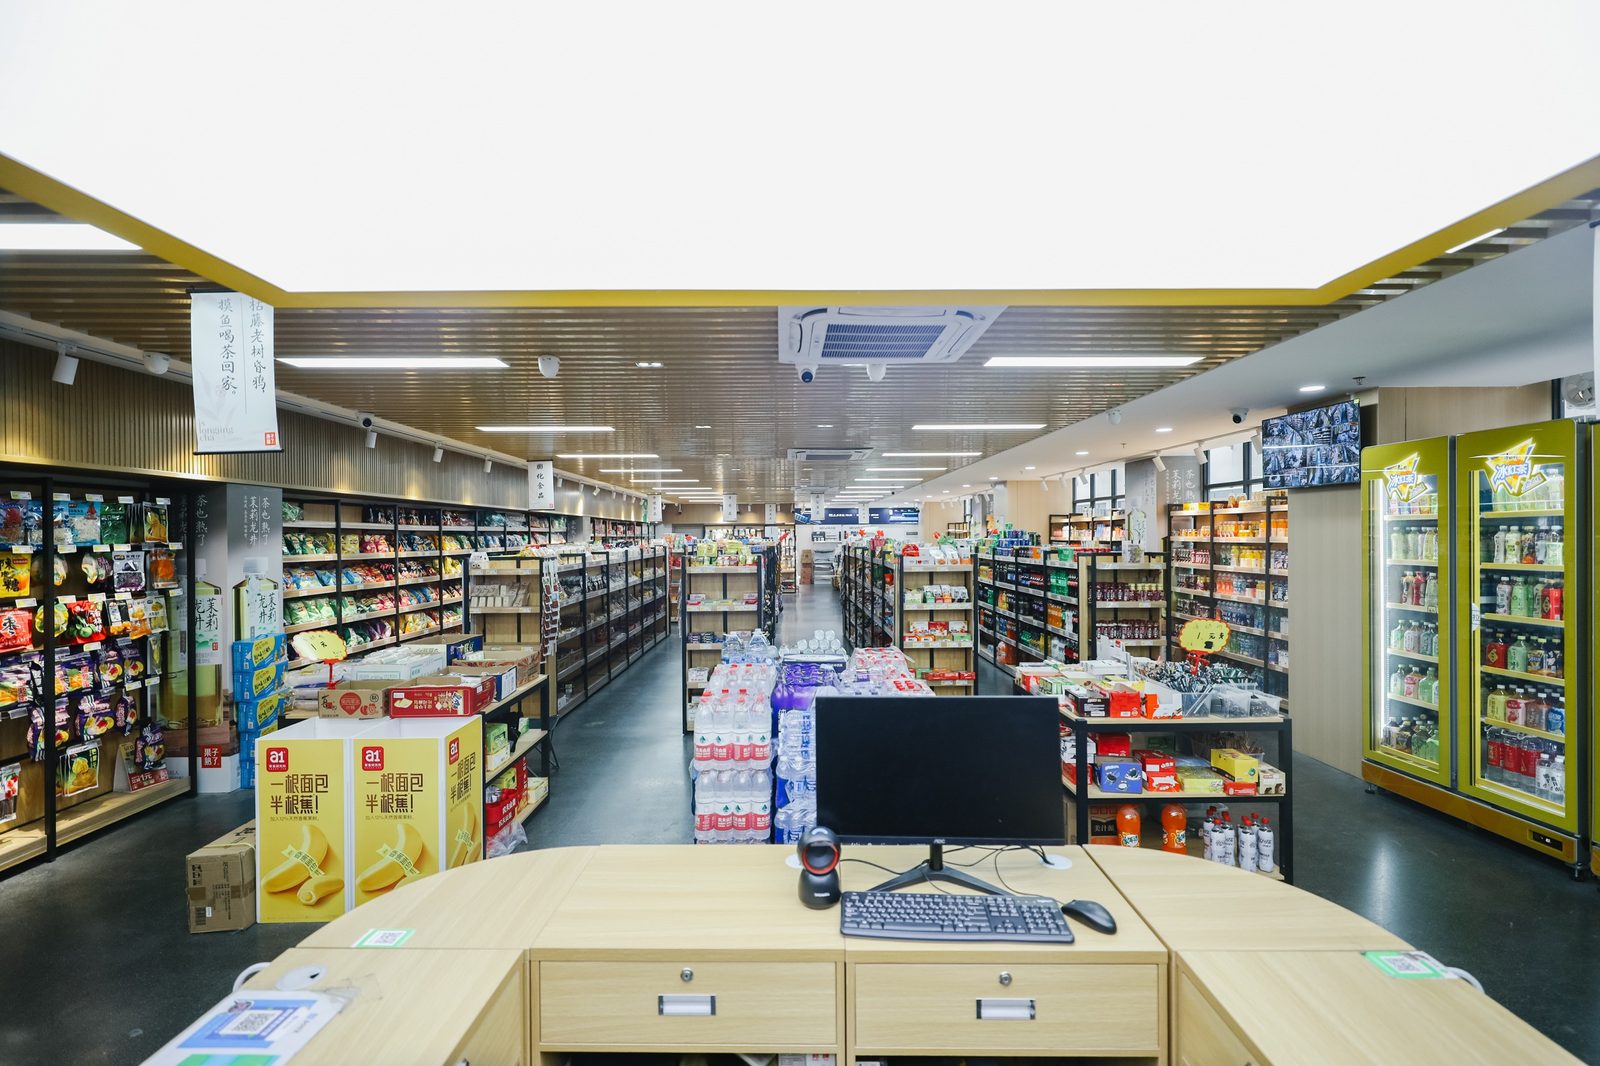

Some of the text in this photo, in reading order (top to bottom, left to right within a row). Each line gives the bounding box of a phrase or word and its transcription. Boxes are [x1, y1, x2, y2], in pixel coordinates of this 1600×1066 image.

[249, 495, 259, 545] 茉莉龙井
[261, 496, 271, 545] 茶也熟了
[270, 751, 285, 763] a1
[365, 750, 381, 763] a1
[450, 751, 476, 781] 一根面包
[270, 773, 329, 793] 一根面包
[366, 772, 424, 792] 一根面包
